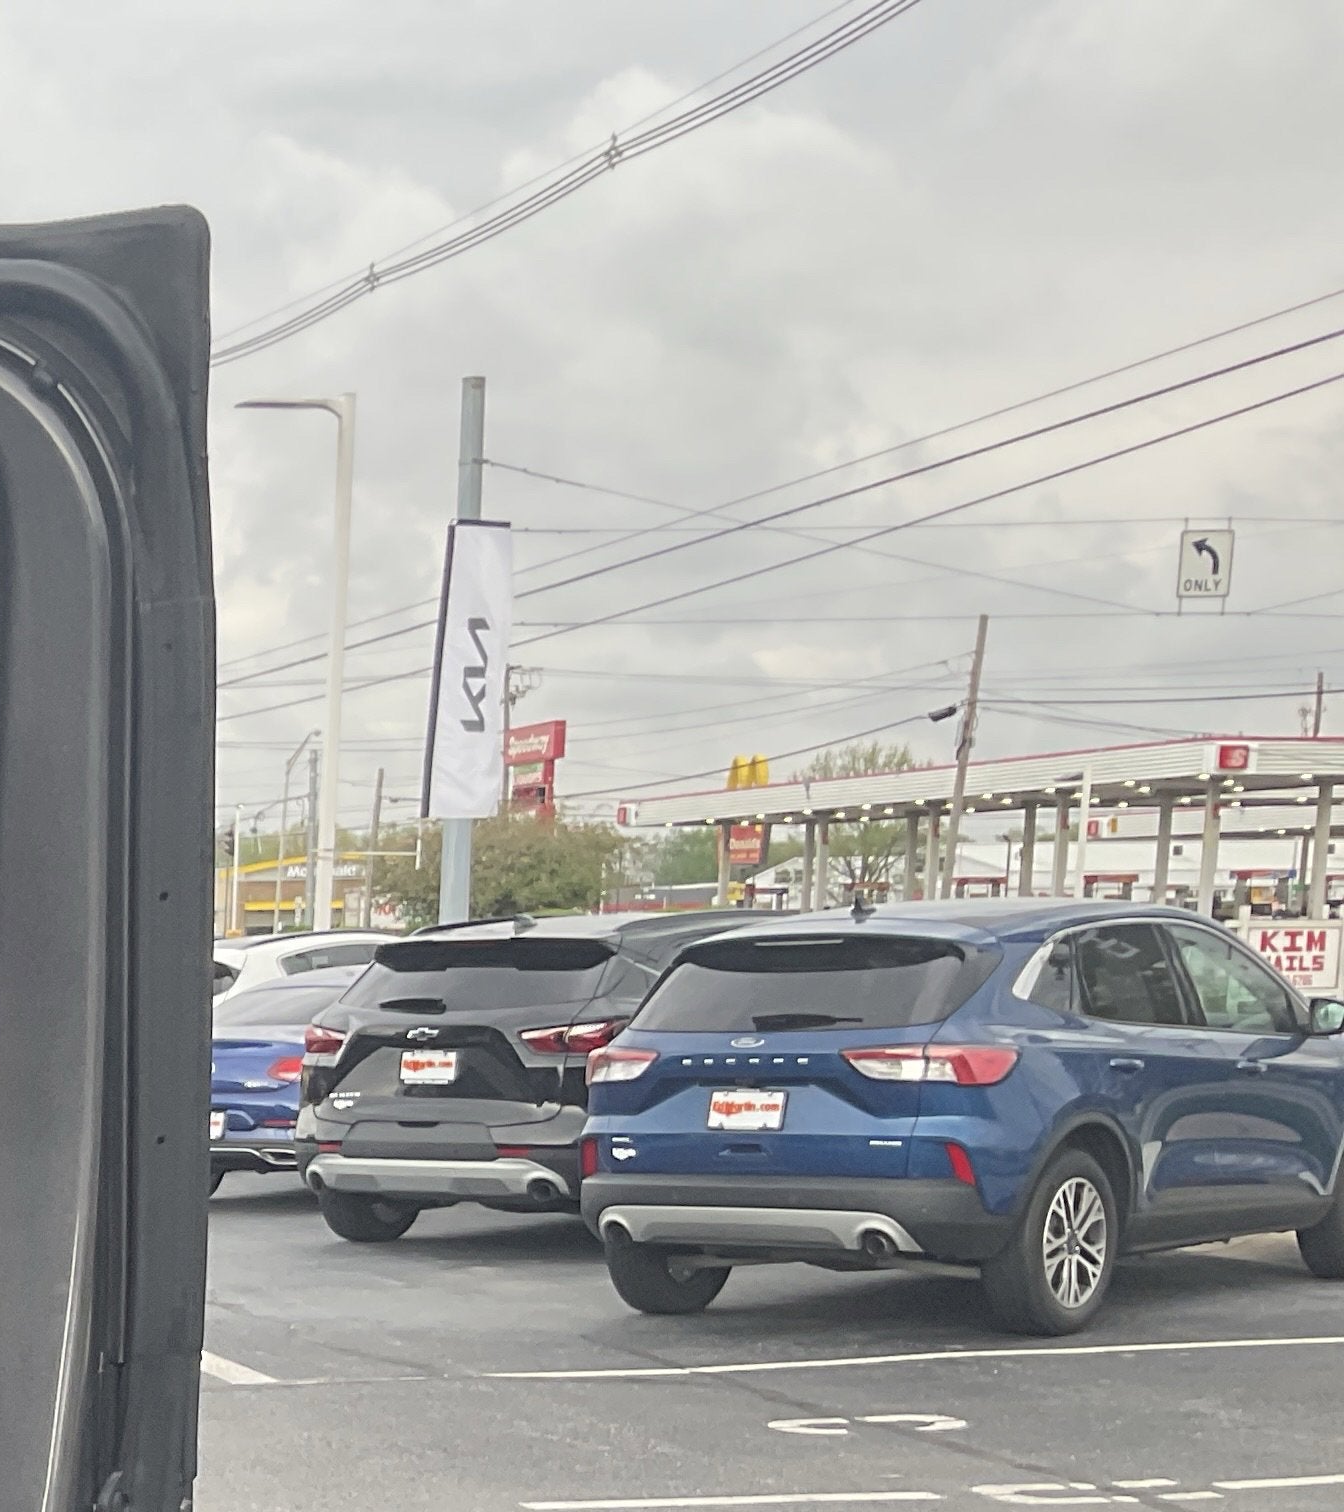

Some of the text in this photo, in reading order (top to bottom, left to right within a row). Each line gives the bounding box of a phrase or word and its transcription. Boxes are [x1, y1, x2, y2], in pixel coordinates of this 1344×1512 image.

[1183, 578, 1222, 592] ONLY
[1260, 930, 1327, 953] KIM
[1267, 955, 1325, 972] AILS
